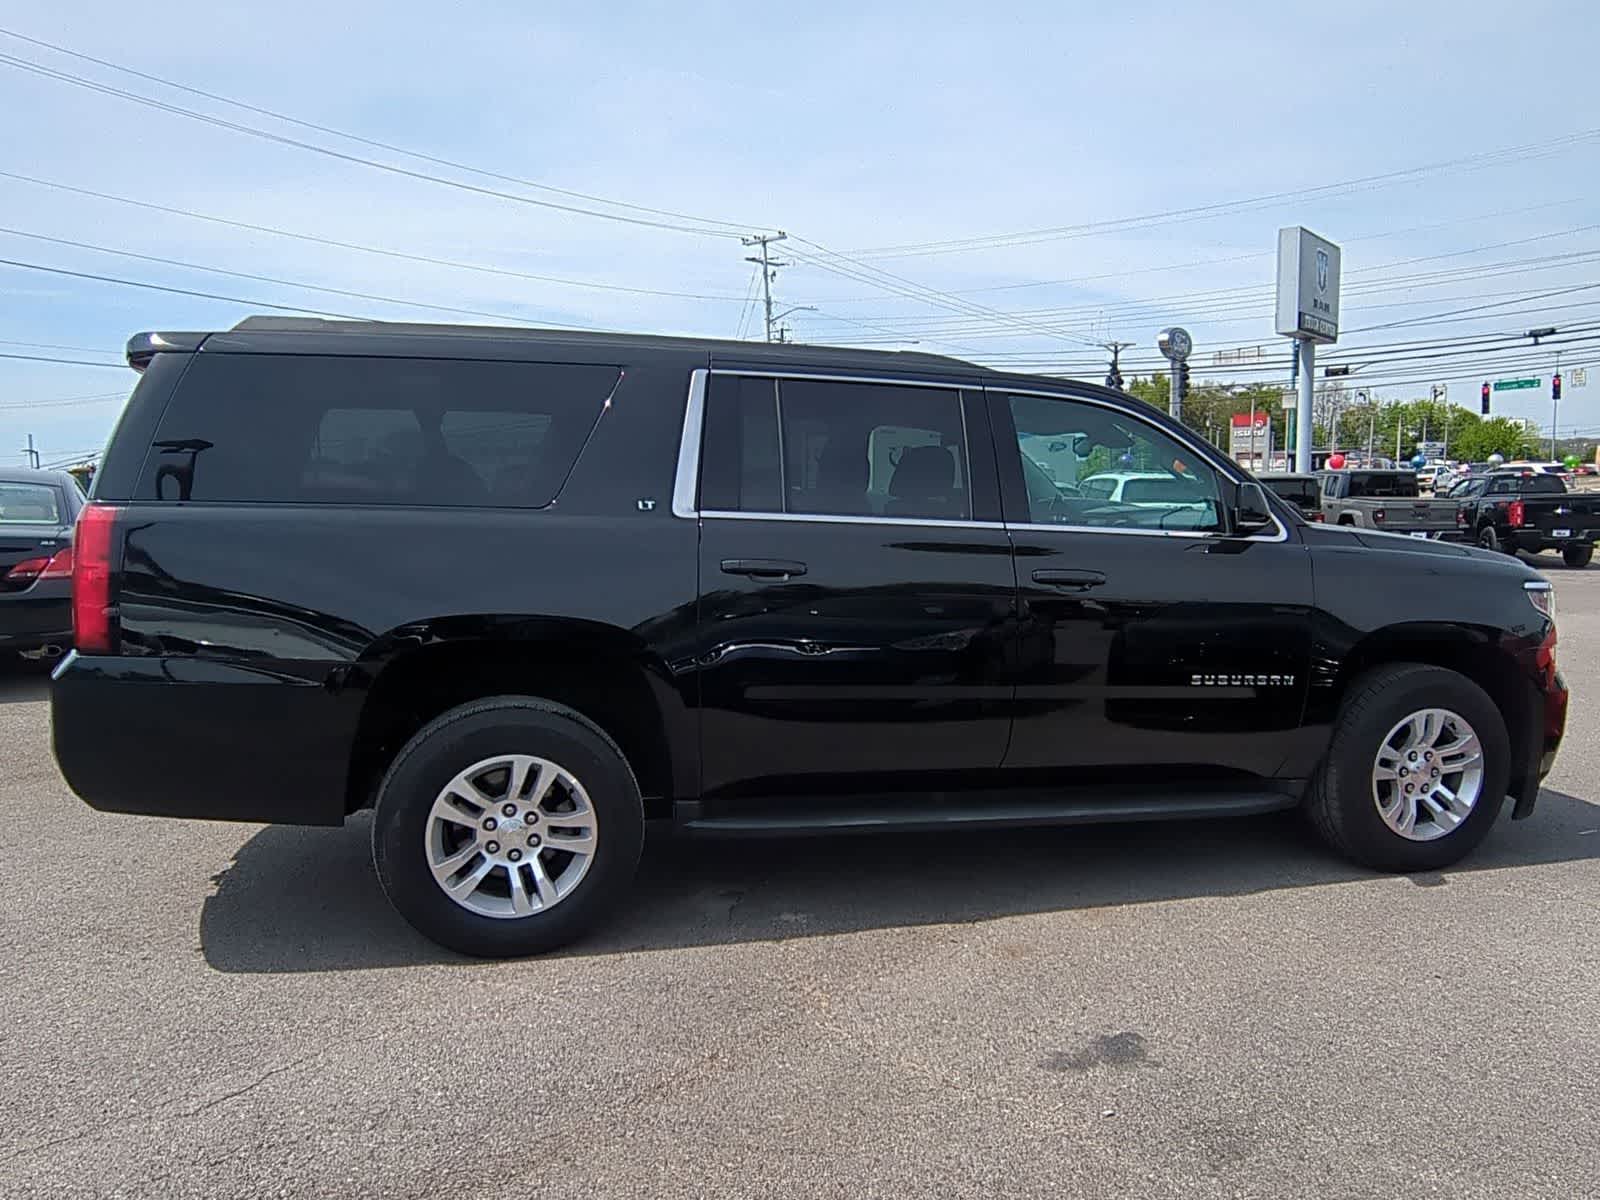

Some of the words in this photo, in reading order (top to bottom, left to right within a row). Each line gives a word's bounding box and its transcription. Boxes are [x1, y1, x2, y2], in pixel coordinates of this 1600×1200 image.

[1313, 299, 1330, 313] RAM
[637, 500, 656, 510] LT
[1190, 674, 1295, 686] SUBURBAN
